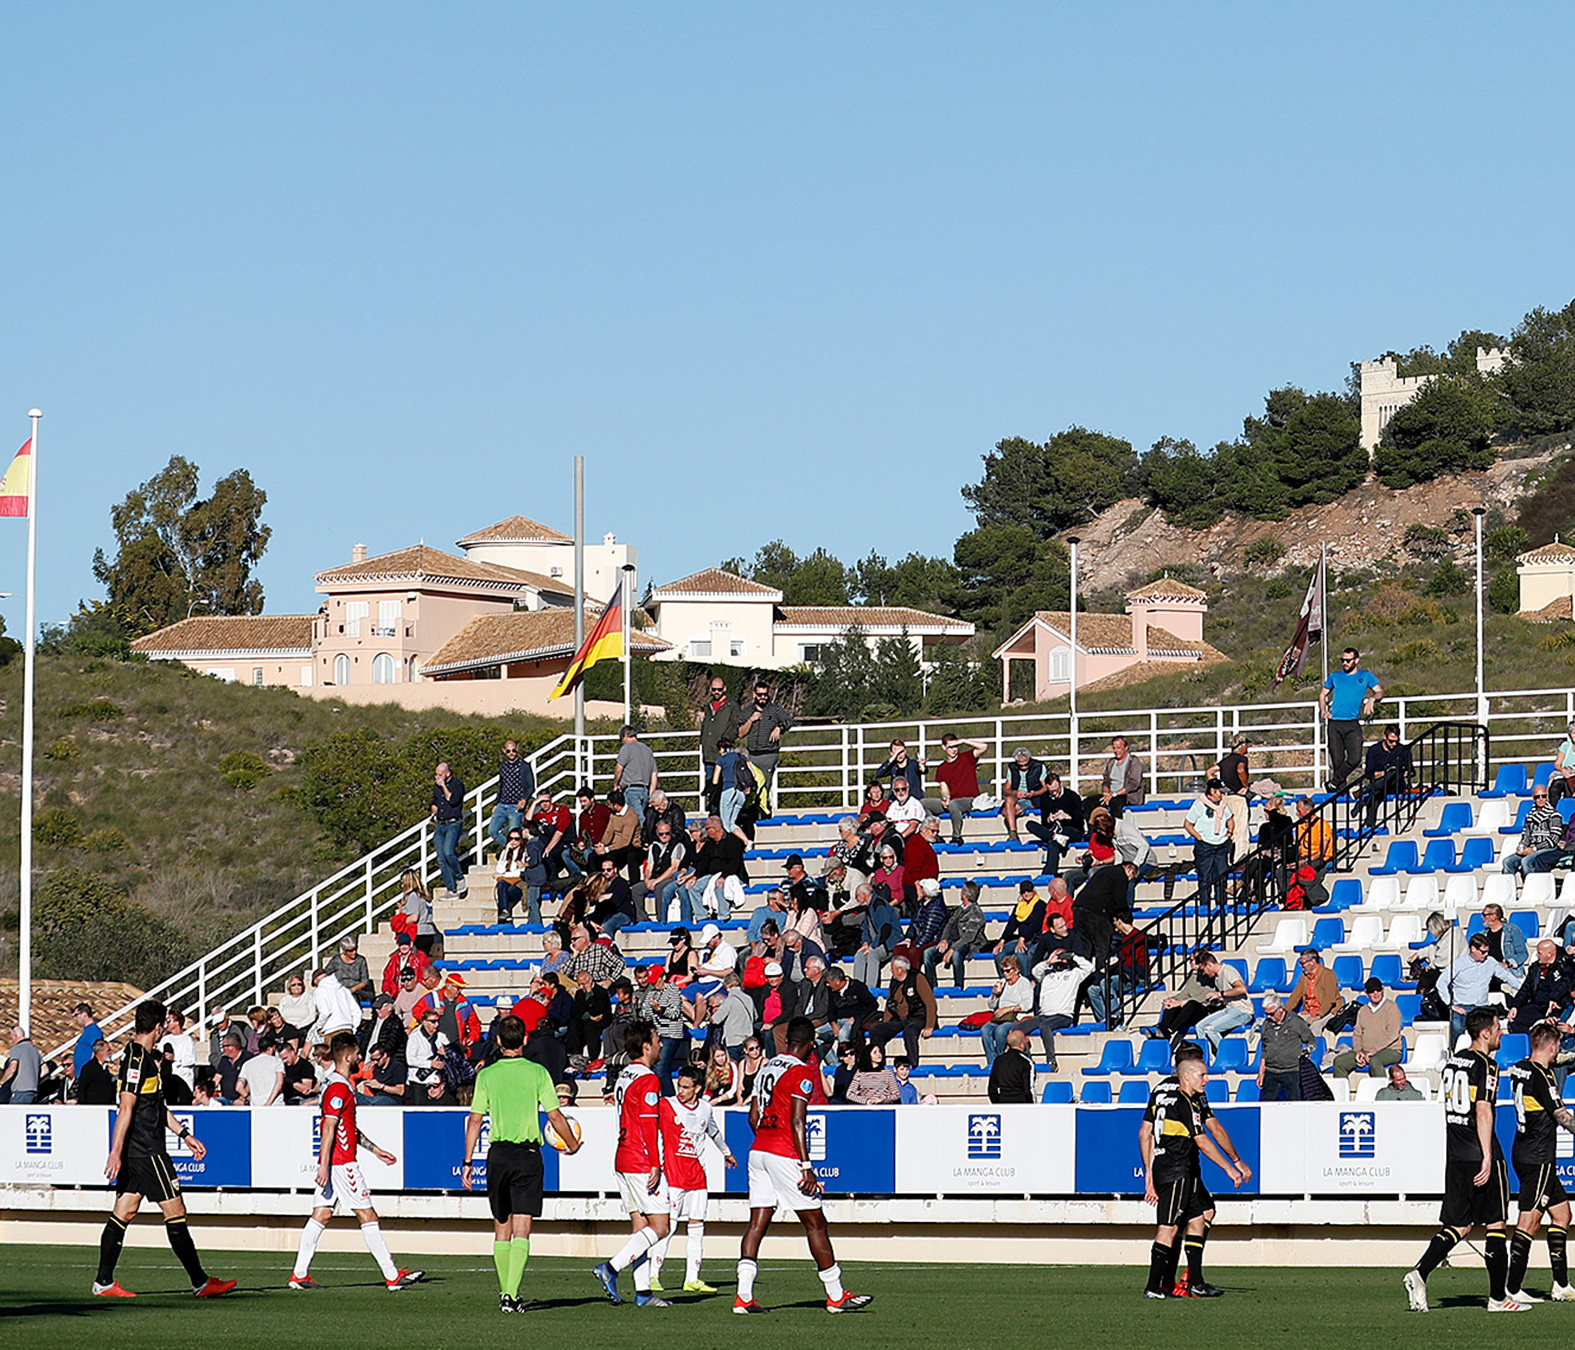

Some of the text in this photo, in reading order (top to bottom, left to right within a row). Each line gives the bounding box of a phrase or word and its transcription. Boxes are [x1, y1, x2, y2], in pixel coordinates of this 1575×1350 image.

[1443, 1068, 1471, 1114] 20
[188, 1162, 205, 1173] CLUB
[452, 1166, 461, 1176] LA
[820, 1167, 839, 1178] CLUB
[953, 1167, 1016, 1177] LA MANGA CLUB
[1133, 1167, 1144, 1177] LA
[1323, 1167, 1391, 1177] LA MANGA CLUB
